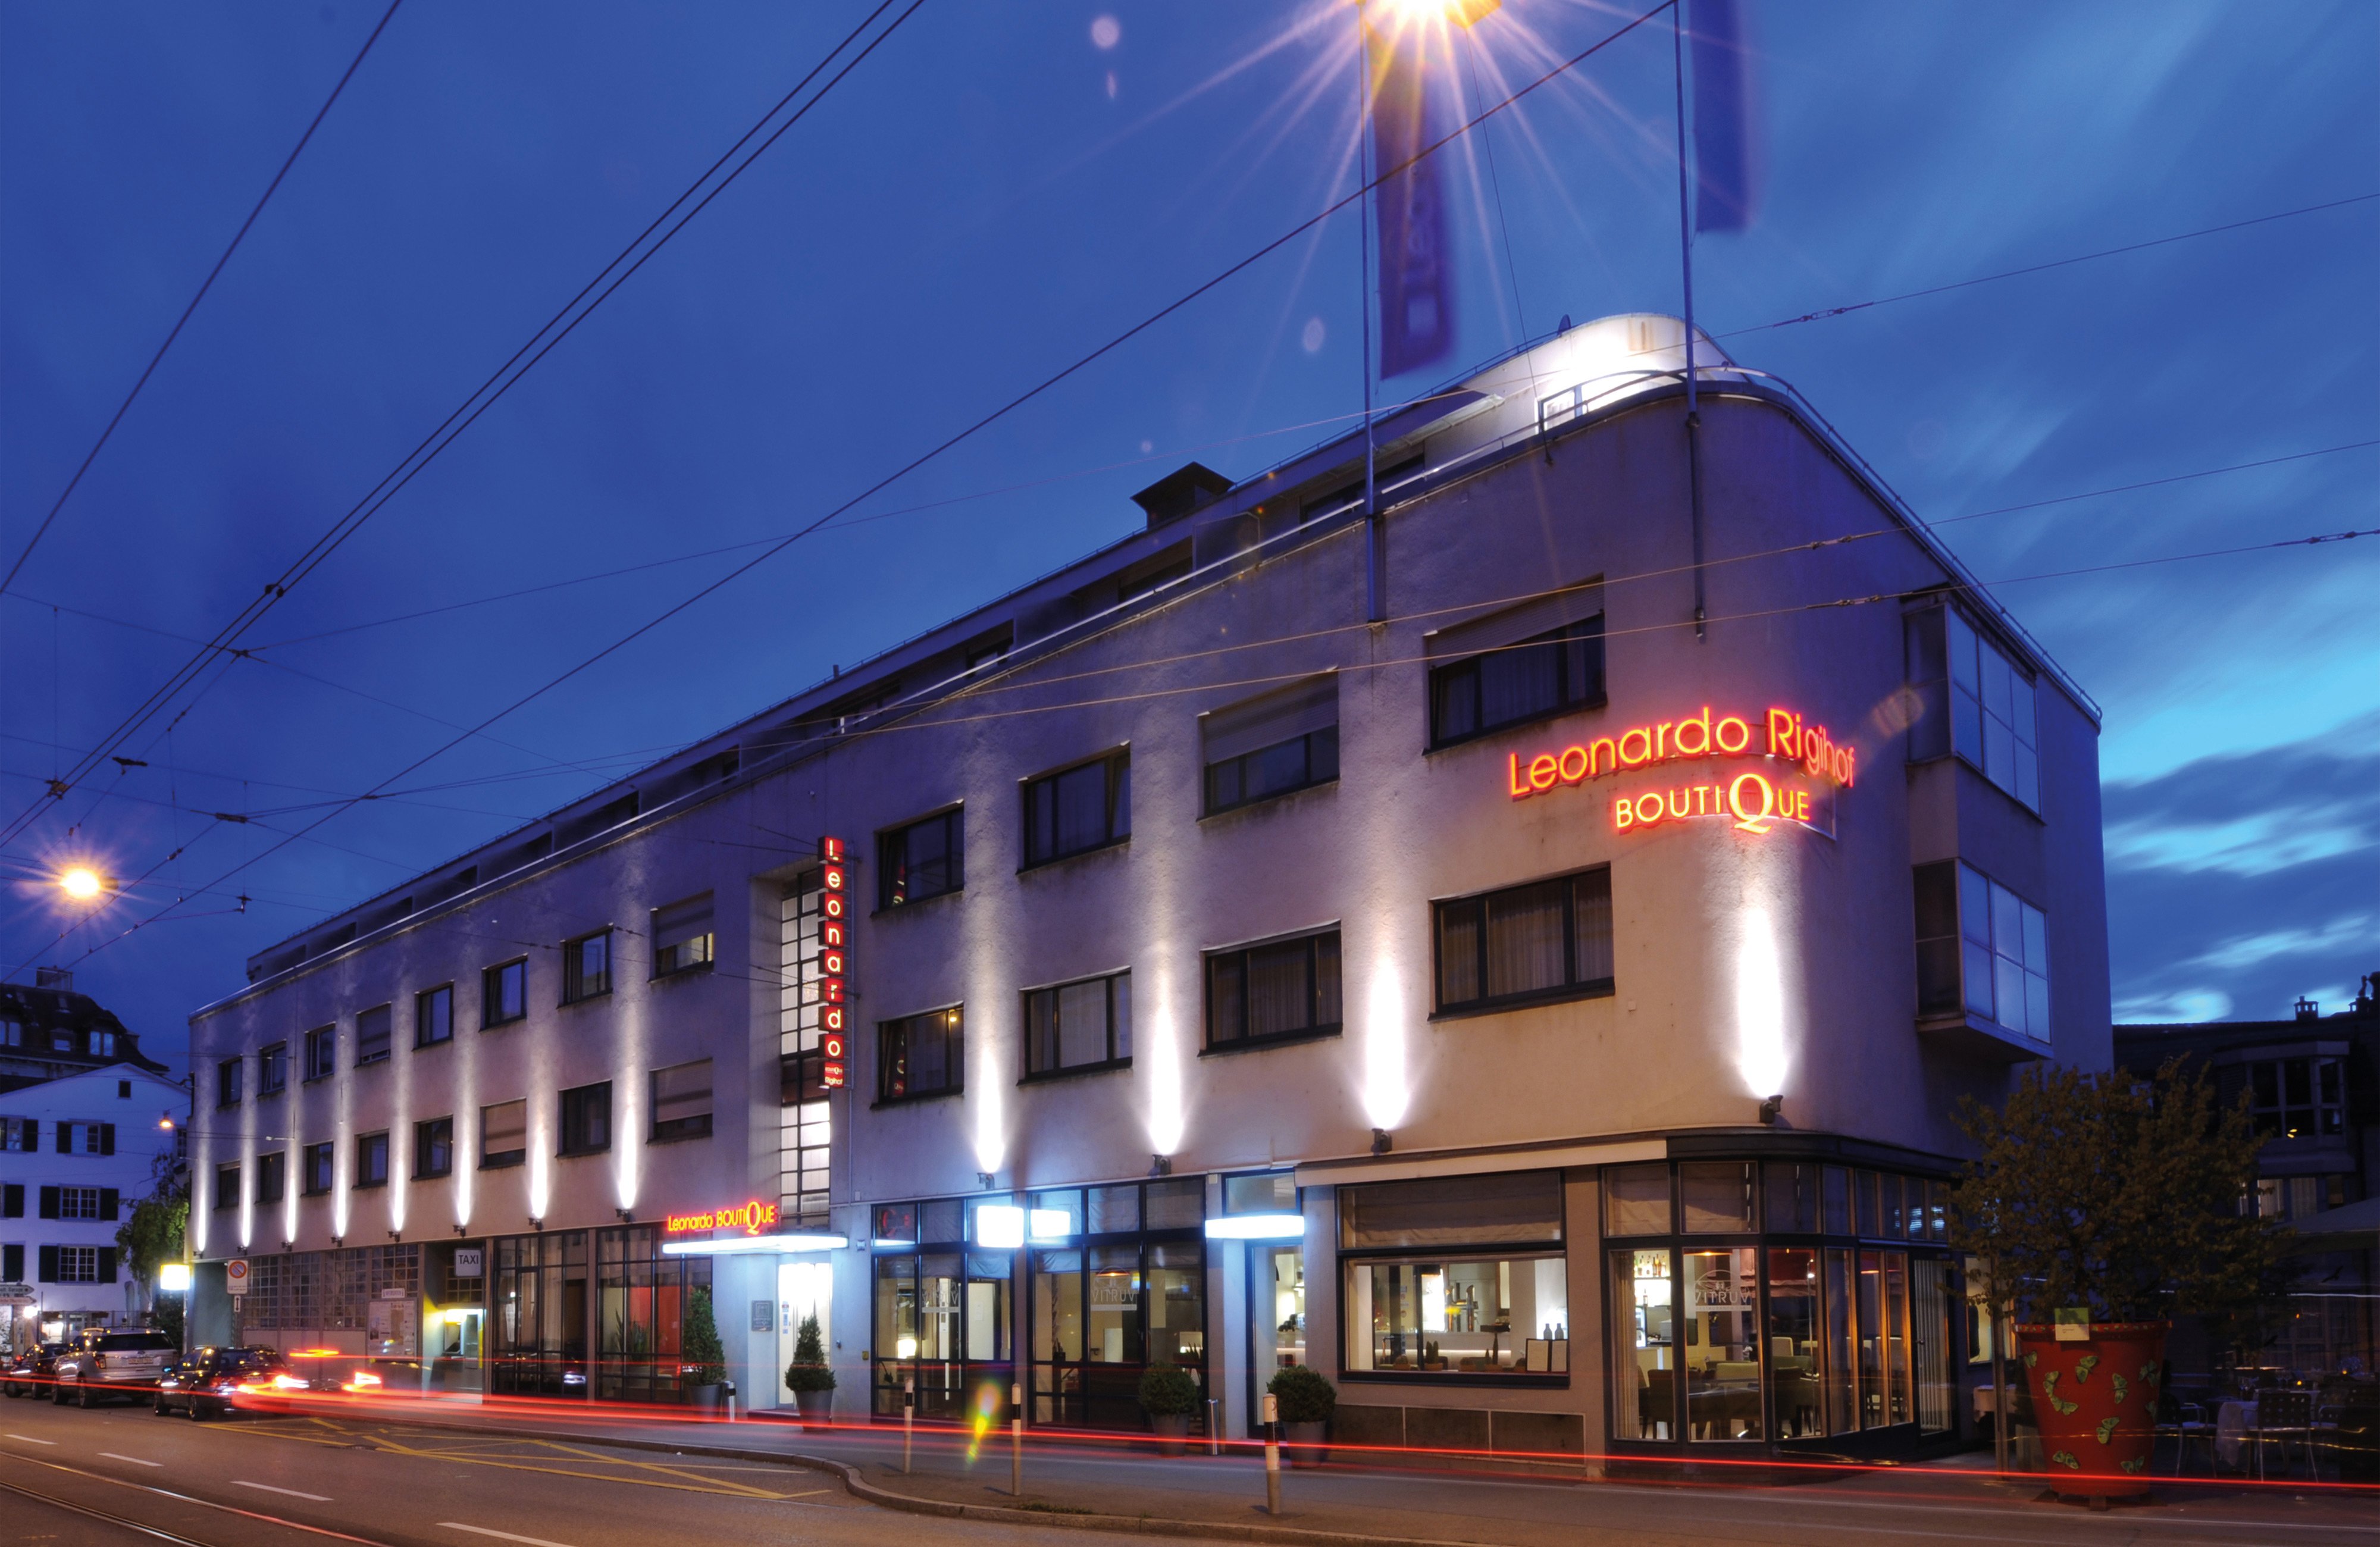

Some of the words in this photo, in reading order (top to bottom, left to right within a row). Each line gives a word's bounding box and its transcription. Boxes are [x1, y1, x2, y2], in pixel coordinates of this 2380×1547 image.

[1510, 706, 1749, 797] Leonardo
[1768, 708, 1855, 787] Rigihof
[1615, 772, 1810, 834] BOUTIQUE
[826, 840, 841, 1057] Leonardo
[668, 1212, 713, 1232] Leonardo
[716, 1201, 775, 1235] BOUTIQUE
[458, 1255, 478, 1264] TAXI
[1091, 1289, 1135, 1302] VITRUV
[1692, 1291, 1750, 1304] VITRUV
